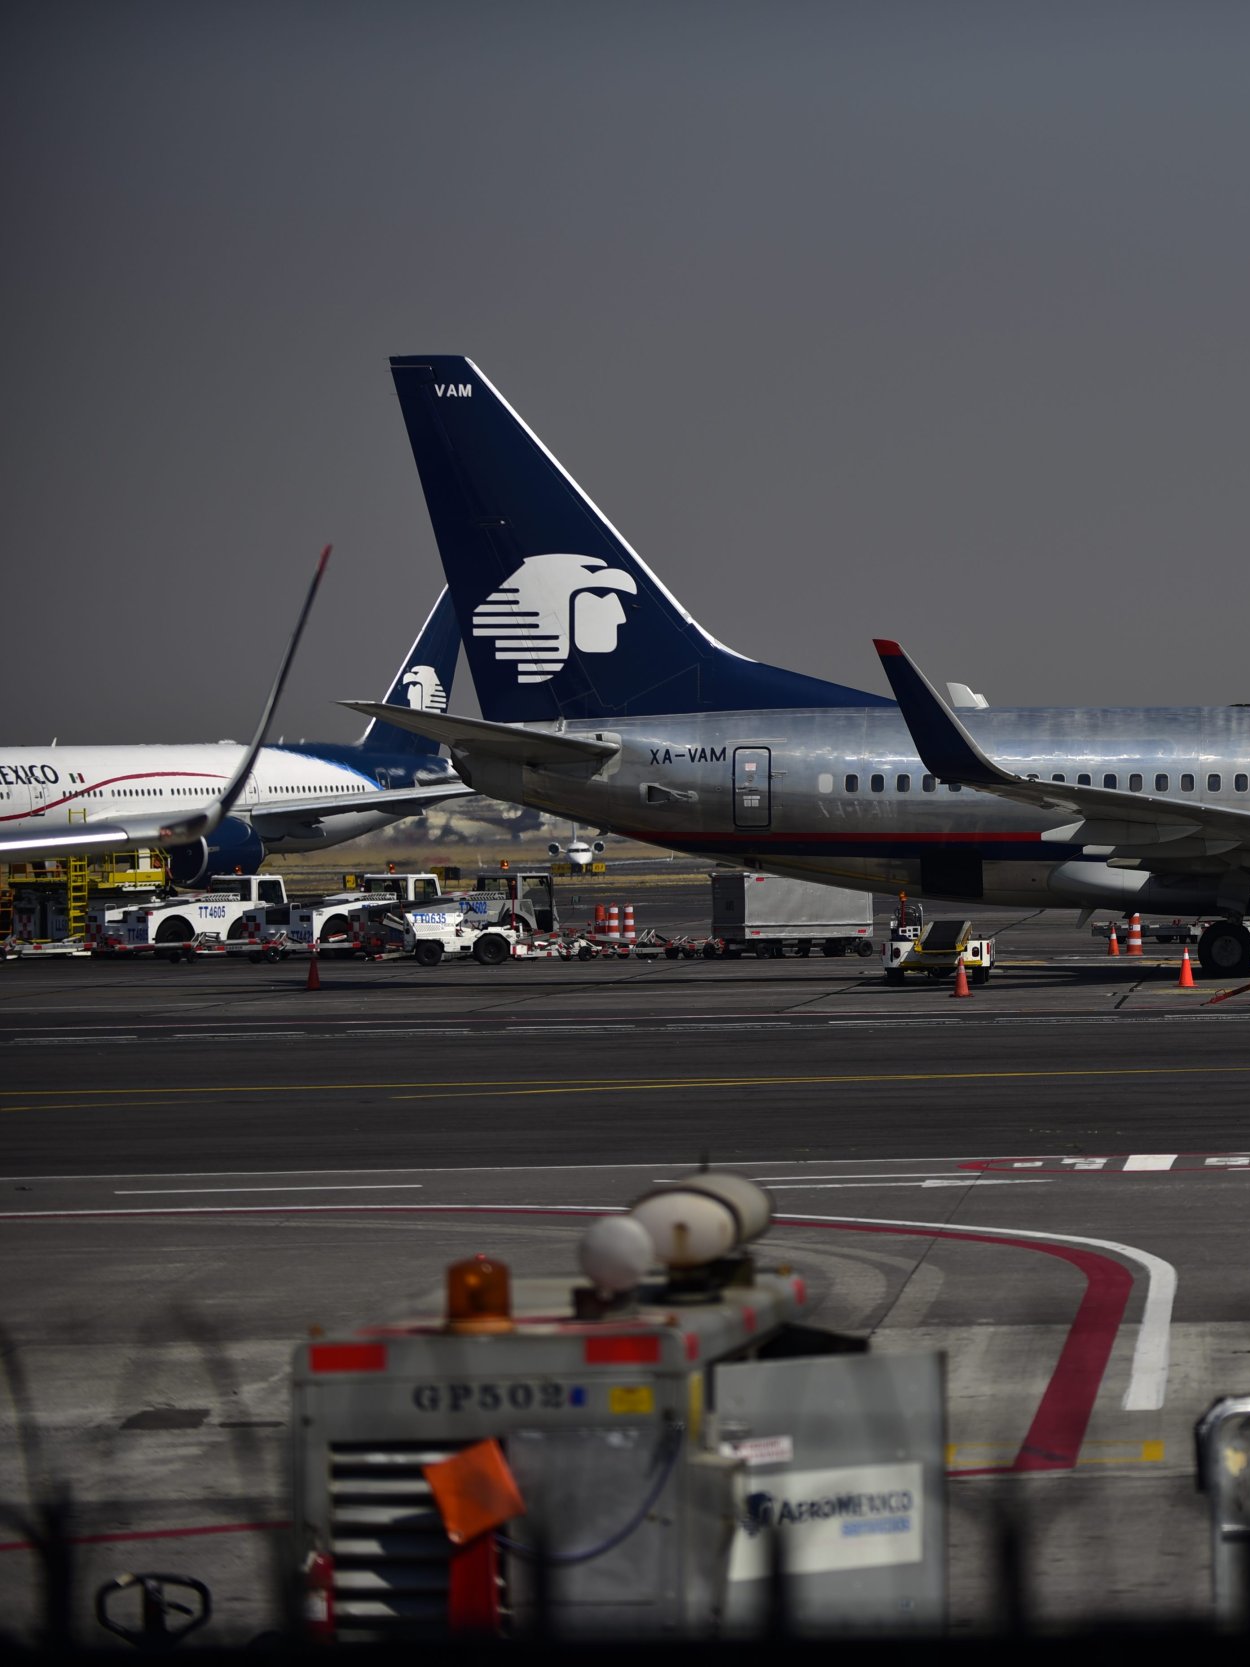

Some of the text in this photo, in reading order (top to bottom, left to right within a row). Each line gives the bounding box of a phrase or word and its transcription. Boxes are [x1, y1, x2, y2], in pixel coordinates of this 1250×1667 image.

[434, 383, 472, 398] VAM
[650, 746, 727, 765] XA-VAM
[0, 764, 59, 785] EXICO
[198, 905, 226, 919] TT4605
[412, 1382, 564, 1412] GP502
[777, 1491, 913, 1526] AEROMEXICO
